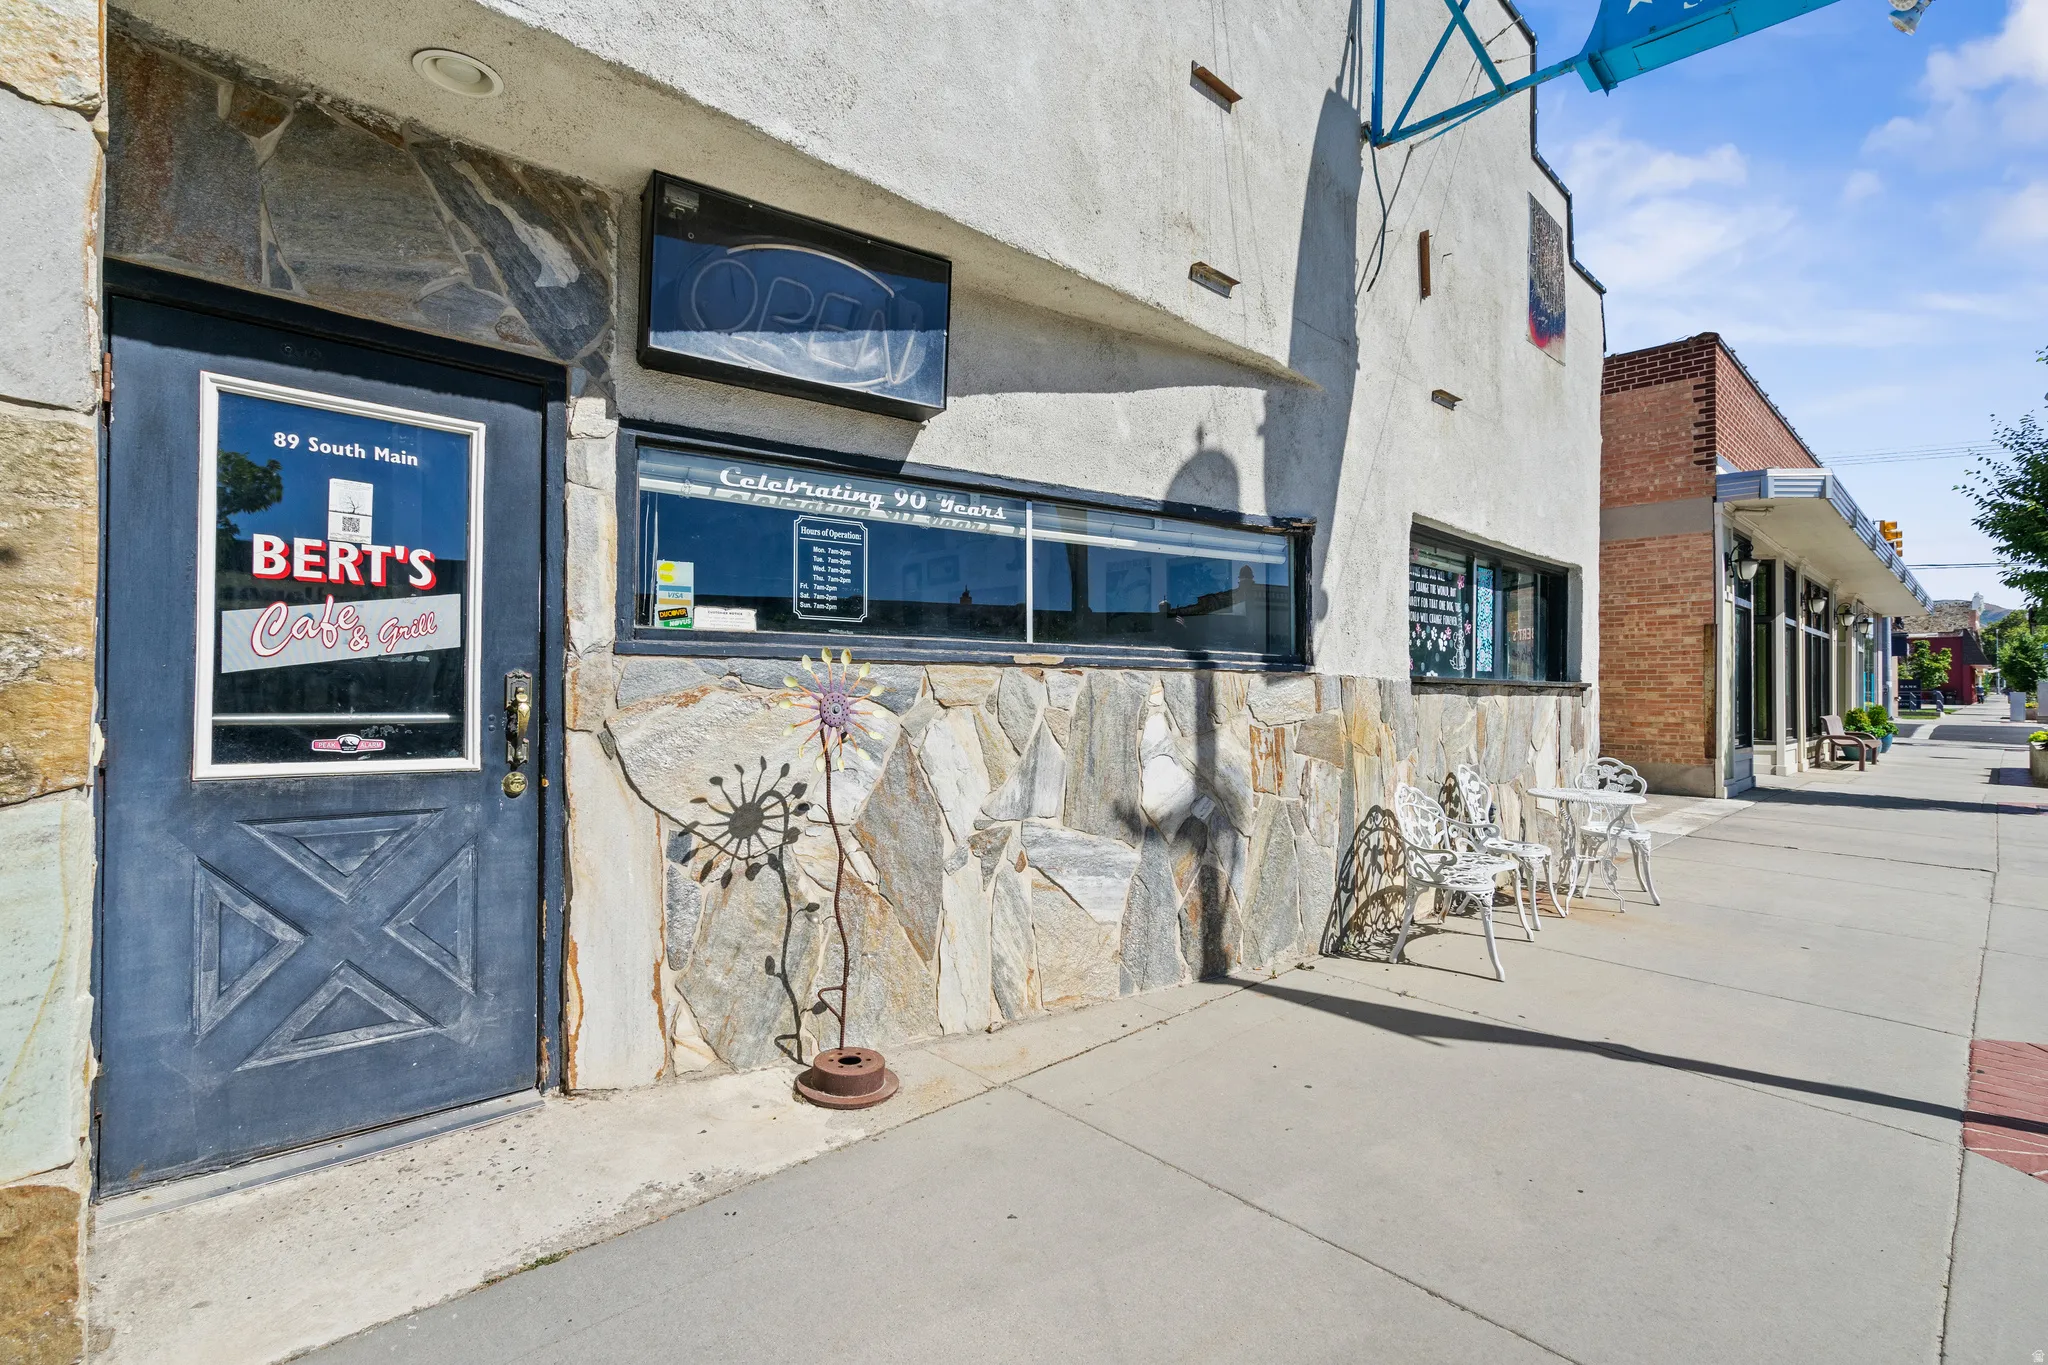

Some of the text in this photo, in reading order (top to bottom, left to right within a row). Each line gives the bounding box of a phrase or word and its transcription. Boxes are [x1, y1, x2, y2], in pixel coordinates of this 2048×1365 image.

[690, 258, 917, 386] OPEN
[274, 432, 419, 467] 89 South Main
[719, 466, 1007, 520] Celebrating 90 Years
[800, 526, 862, 541] Hours of Operation:
[812, 546, 852, 556] Mon. 7am-2pm
[252, 533, 437, 590] BERT'S
[827, 557, 852, 565] 7am-2pm
[827, 566, 852, 575] 7am-2pm
[812, 574, 852, 584] Thu. 7am-2pm
[799, 582, 810, 590] Fri.
[813, 583, 838, 592] 7am-2pm
[813, 592, 838, 601] 7am-2pm
[799, 601, 838, 610] Sun. 7am-2pm
[659, 608, 687, 618] DISCOVER
[669, 618, 692, 627] NOVUS
[348, 625, 370, 652] &
